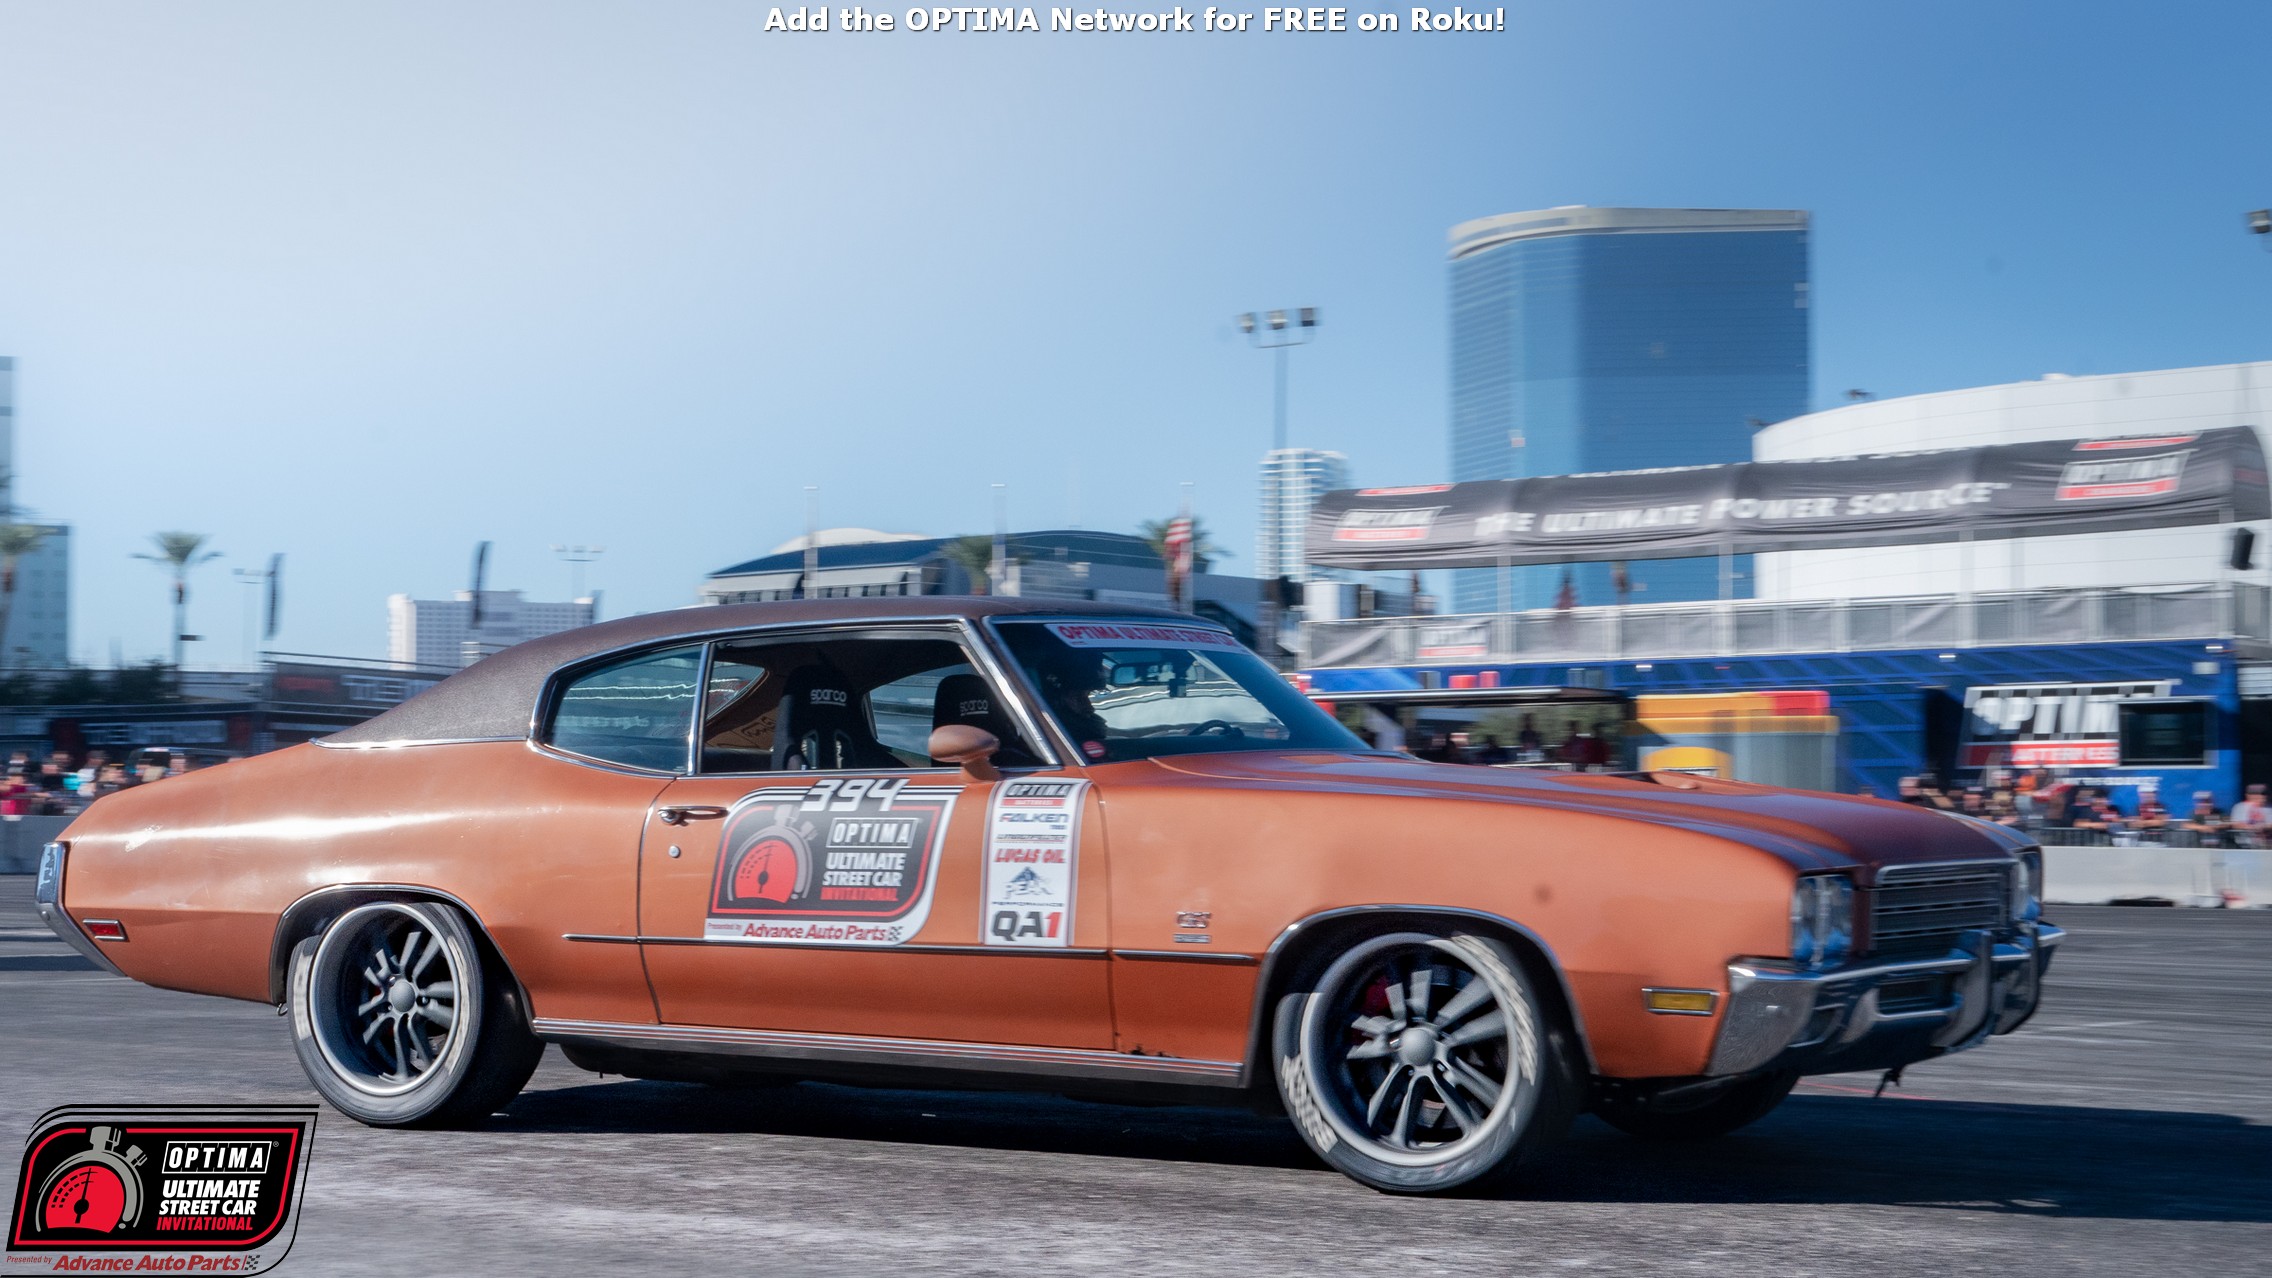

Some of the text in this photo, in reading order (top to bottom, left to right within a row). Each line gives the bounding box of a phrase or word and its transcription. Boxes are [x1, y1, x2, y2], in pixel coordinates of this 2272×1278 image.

[1541, 505, 1703, 533] ULTIMATE
[1708, 498, 1838, 520] POWER
[1057, 625, 1122, 639] OPTIMA
[809, 688, 848, 702] sparco
[800, 779, 909, 811] 394
[1005, 784, 1073, 796] OPTIMA
[832, 822, 909, 844] OPTIMA
[825, 852, 907, 870] ULTIMATE
[993, 848, 1067, 863] LUCAS OIL
[822, 871, 903, 887] STREET CAR
[743, 923, 804, 940] Advance
[804, 924, 844, 940] Auto
[845, 925, 888, 941] Parts
[992, 910, 1063, 942] QA1
